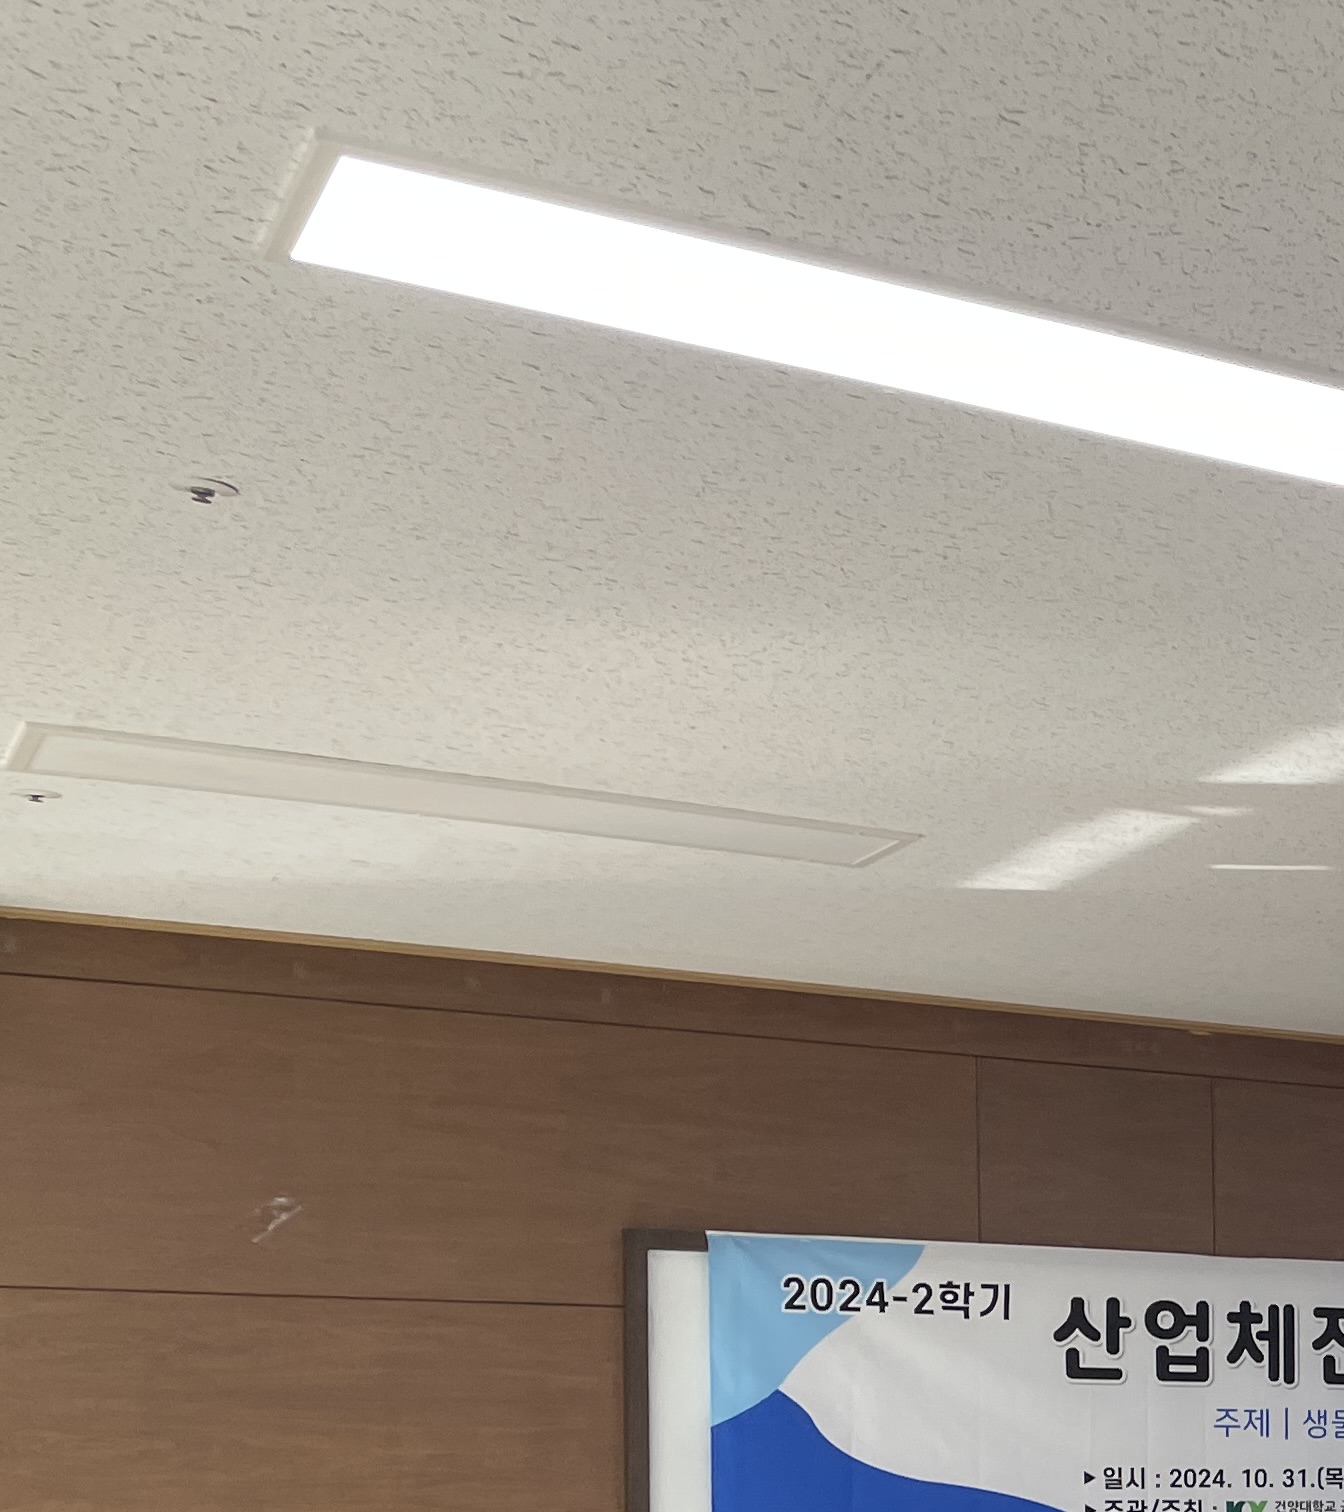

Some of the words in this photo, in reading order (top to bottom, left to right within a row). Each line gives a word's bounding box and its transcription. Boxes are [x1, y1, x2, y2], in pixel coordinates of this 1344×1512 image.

[782, 1276, 1012, 1320] 2024-2학기
[1213, 1407, 1271, 1439] 주제
[1103, 1466, 1146, 1490] 일시
[1169, 1468, 1233, 1489] 2024.
[1241, 1469, 1275, 1489] 10.
